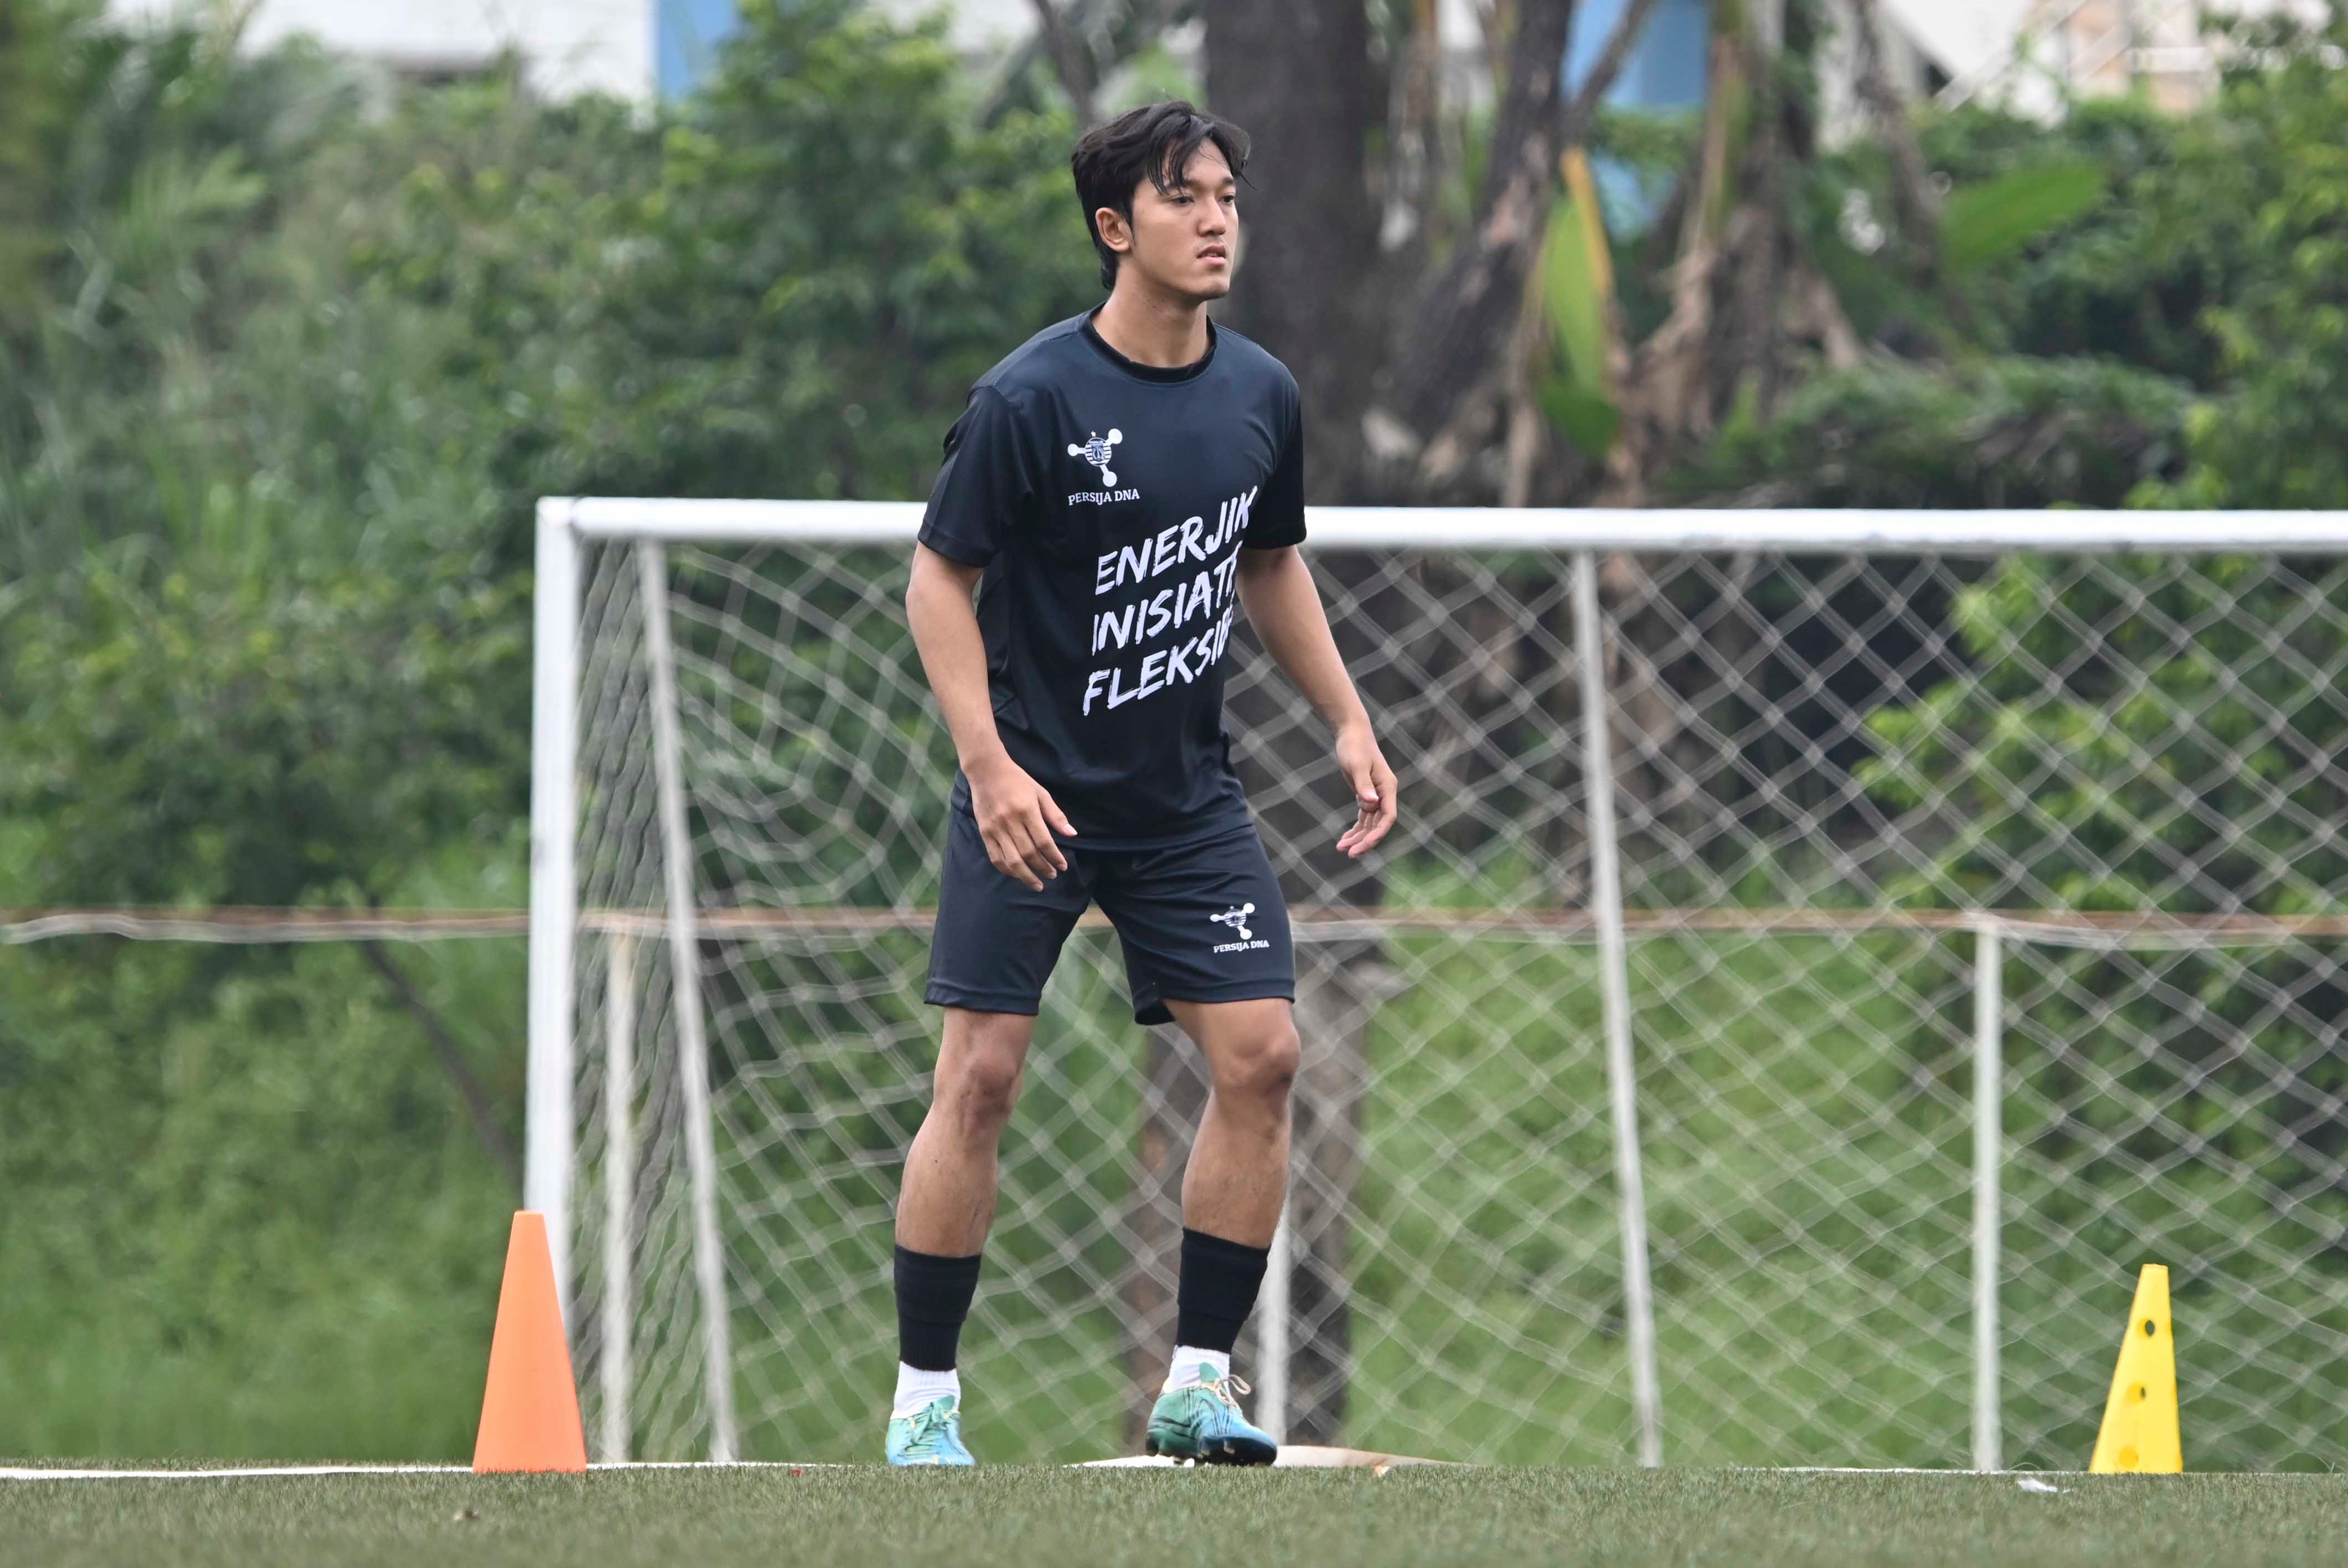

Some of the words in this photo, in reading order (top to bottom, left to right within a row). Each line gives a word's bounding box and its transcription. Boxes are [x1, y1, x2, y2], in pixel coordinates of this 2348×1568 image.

[1068, 491, 1112, 506] PERSIJA
[1114, 488, 1140, 502] DNA
[1095, 486, 1258, 595] ENERJIK
[1213, 941, 1250, 954] PERSIJA
[1250, 940, 1270, 949] DNA
